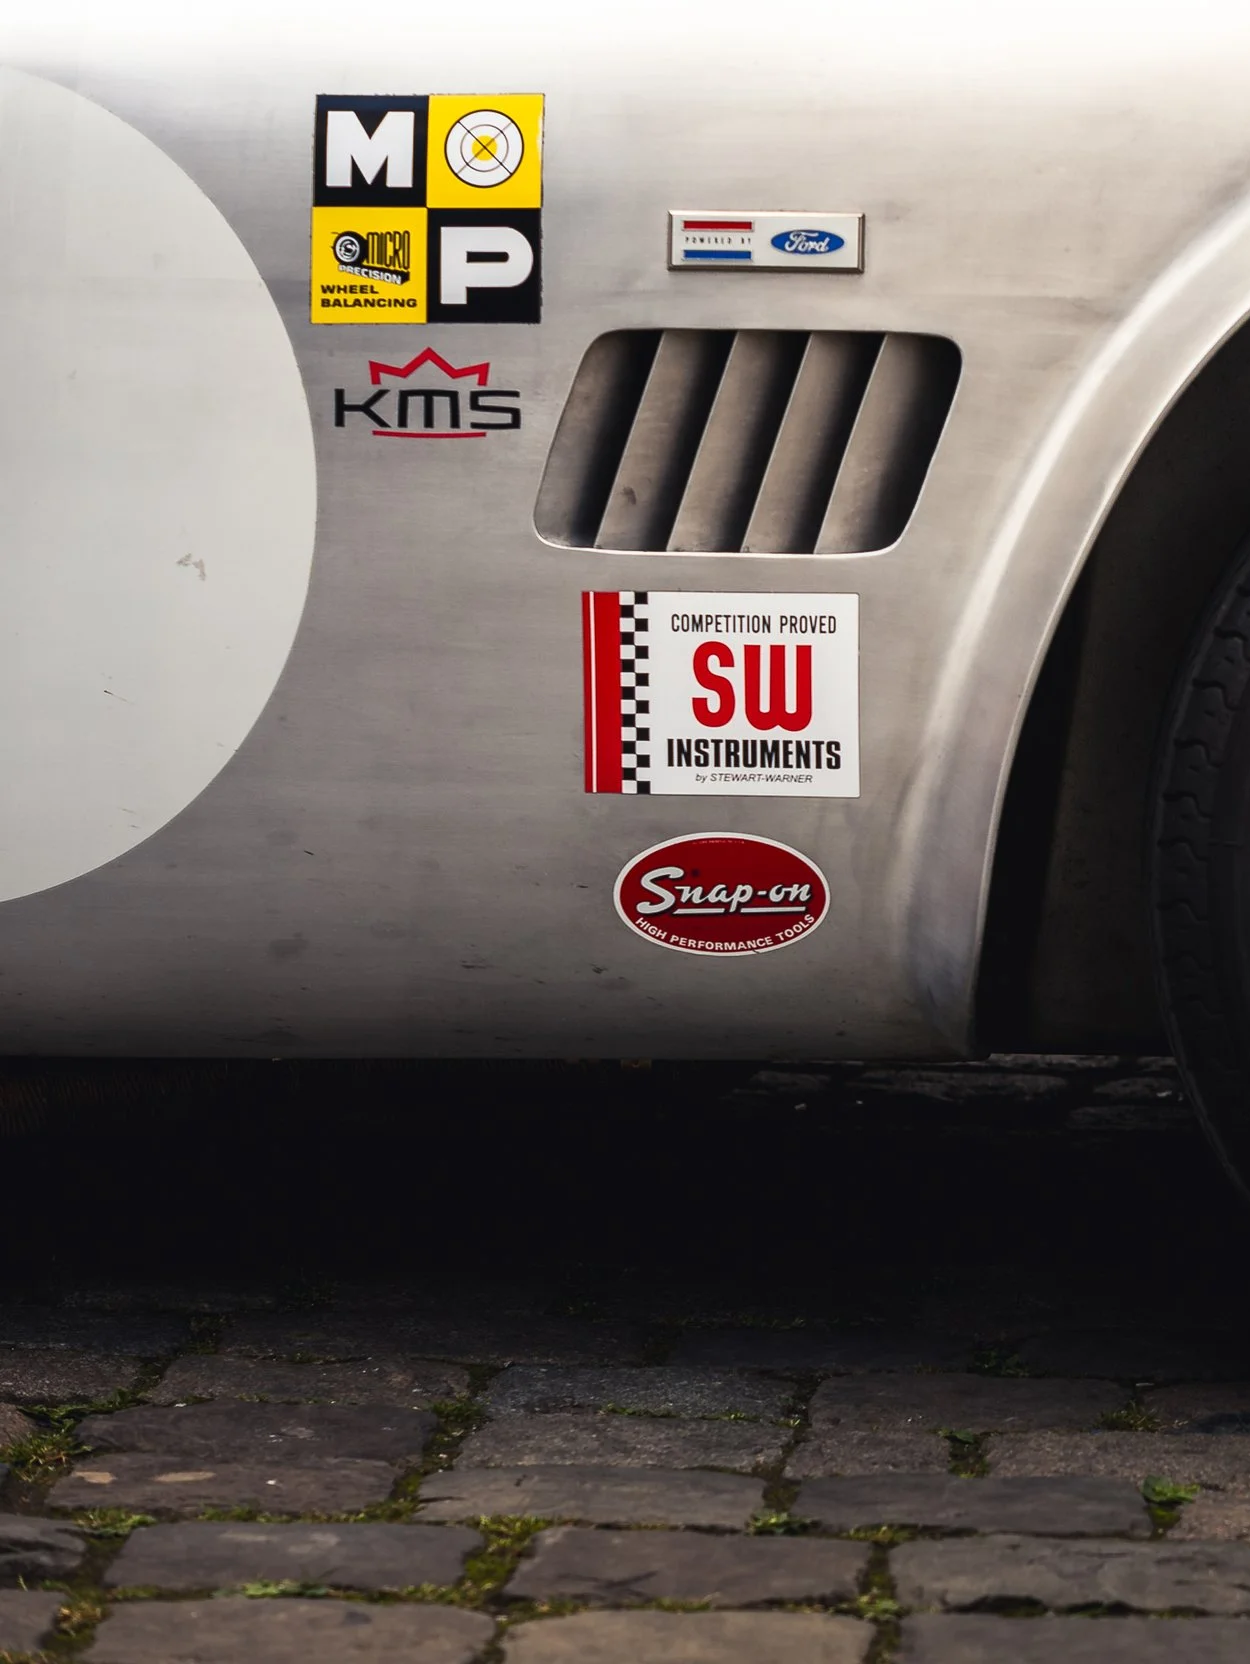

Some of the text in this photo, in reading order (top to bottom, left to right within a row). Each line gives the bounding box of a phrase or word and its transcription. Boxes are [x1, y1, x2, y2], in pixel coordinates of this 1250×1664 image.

[326, 110, 415, 188] M
[366, 230, 410, 270] MICRO
[784, 231, 830, 252] Ford
[338, 264, 402, 285] PRECISION
[440, 226, 534, 305] P
[320, 285, 379, 294] WHEEL
[320, 298, 417, 308] BALANCING
[334, 388, 521, 430] KMS
[671, 614, 837, 635] COMPETITION PROVED
[691, 641, 813, 732] SW
[666, 738, 841, 770] INSTRUMENTS
[695, 773, 813, 783] by STEWART-WARNER
[636, 866, 812, 914] Snap-on
[635, 914, 815, 951] HIGH PERFORMANCE TOOLS
